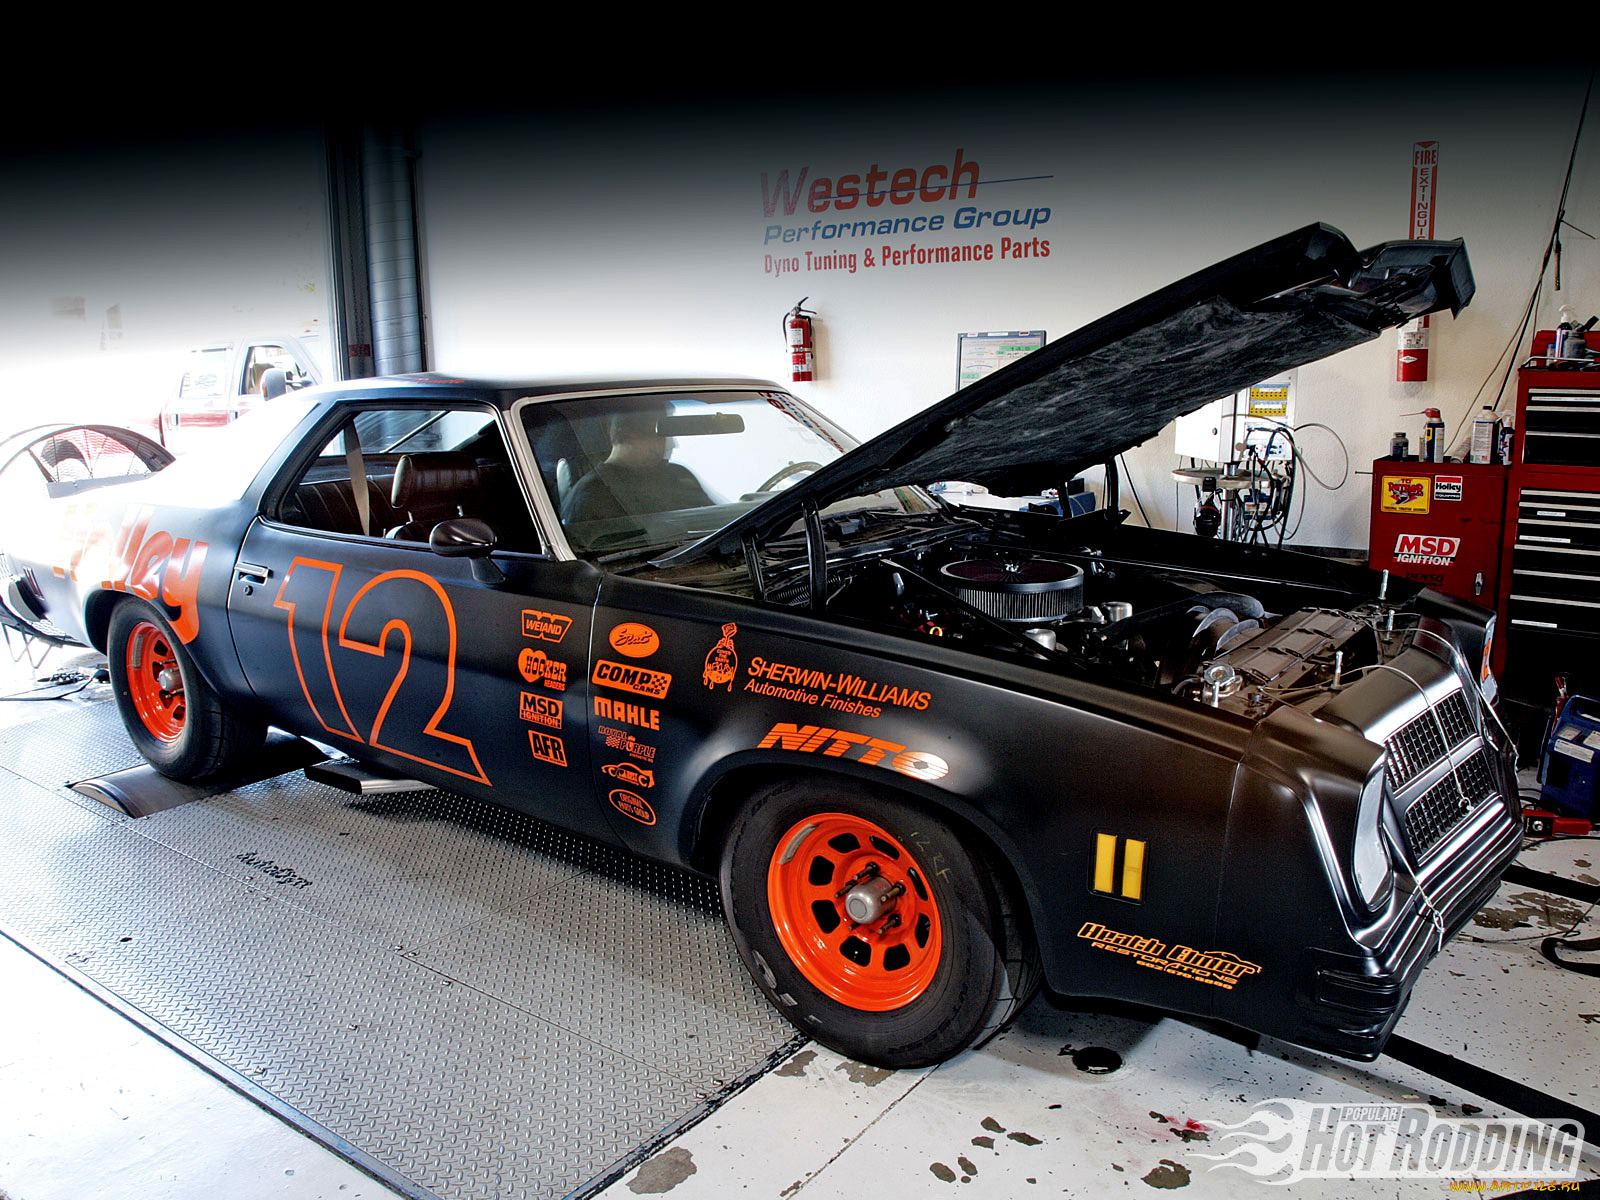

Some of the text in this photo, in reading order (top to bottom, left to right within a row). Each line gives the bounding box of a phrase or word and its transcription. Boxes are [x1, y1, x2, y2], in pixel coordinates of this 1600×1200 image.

[1414, 149, 1437, 166] FIRE
[760, 148, 980, 218] Westech
[763, 206, 1051, 245] Performance Group
[764, 237, 1051, 278] Dyno Tuning & Performance Parts
[1435, 482, 1461, 493] Holley
[1398, 535, 1456, 556] MSD
[1396, 553, 1451, 566] IGNITION
[525, 618, 563, 636] WEIAND
[273, 556, 493, 787] 12
[524, 656, 567, 683] HOOKER
[597, 663, 653, 686] COMP
[632, 683, 661, 695] CAMS
[747, 656, 932, 711] SHERWIN-WILLIAMS
[523, 694, 560, 717] MSD
[743, 678, 882, 718] Automotive Finishes
[523, 709, 559, 728] IGNITION
[593, 695, 660, 731] MAHLE
[532, 732, 565, 762] AFR
[619, 739, 657, 758] PURPLE
[757, 721, 949, 781] NITTO
[1090, 941, 1239, 985] RESTORATIONS
